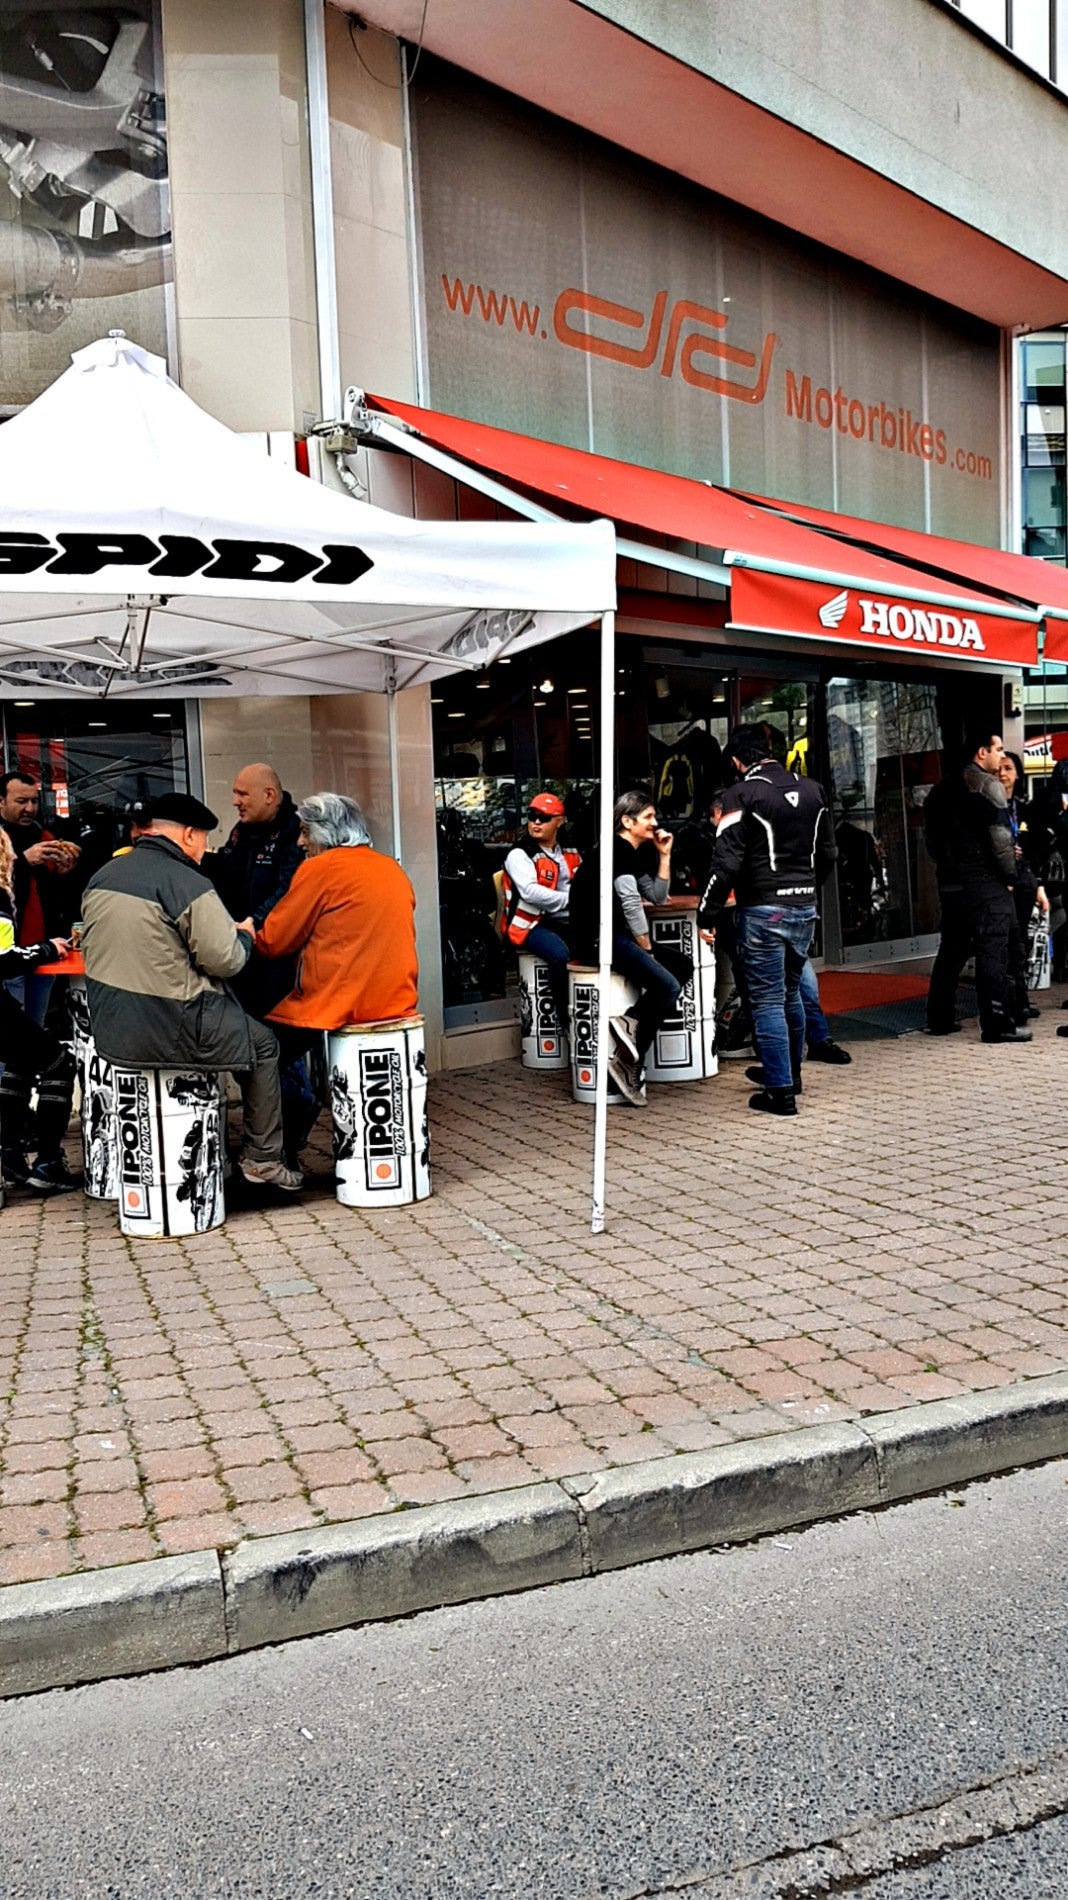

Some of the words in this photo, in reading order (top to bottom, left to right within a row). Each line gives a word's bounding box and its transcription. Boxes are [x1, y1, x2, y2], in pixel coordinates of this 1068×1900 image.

[858, 599, 986, 651] HONDA
[682, 922, 692, 937] OIL
[576, 986, 592, 1066] IPONE
[684, 1002, 696, 1032] 100%
[391, 1053, 400, 1068] OIL
[137, 1077, 148, 1093] OIL
[392, 1069, 403, 1126] MOTORCYCLE
[365, 1053, 394, 1157] IPONE
[118, 1075, 140, 1184] IPONE
[393, 1128, 406, 1156] 100%
[141, 1157, 153, 1186] 100%
